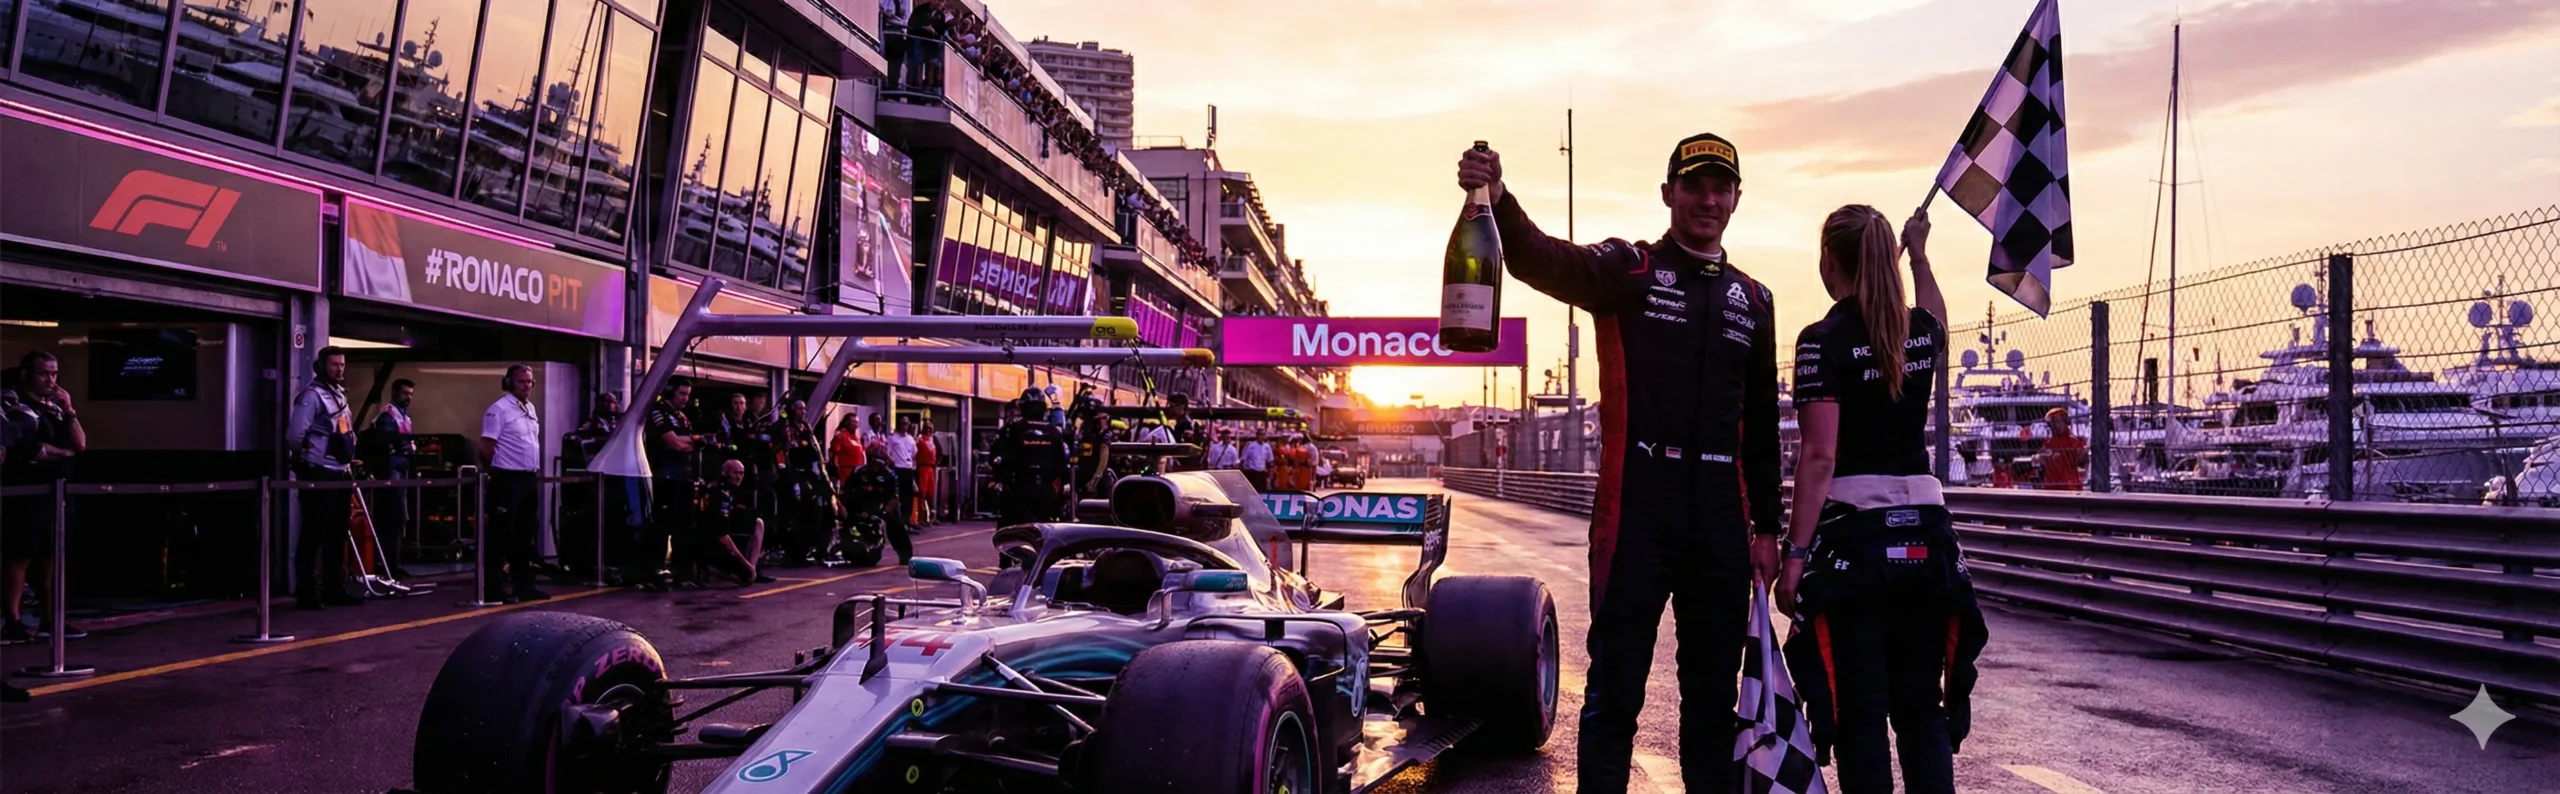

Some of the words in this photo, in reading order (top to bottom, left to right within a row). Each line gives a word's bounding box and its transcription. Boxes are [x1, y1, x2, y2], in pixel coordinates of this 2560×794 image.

[89, 169, 242, 249] F1
[547, 272, 583, 311] PIT
[594, 645, 660, 678] ZERO
